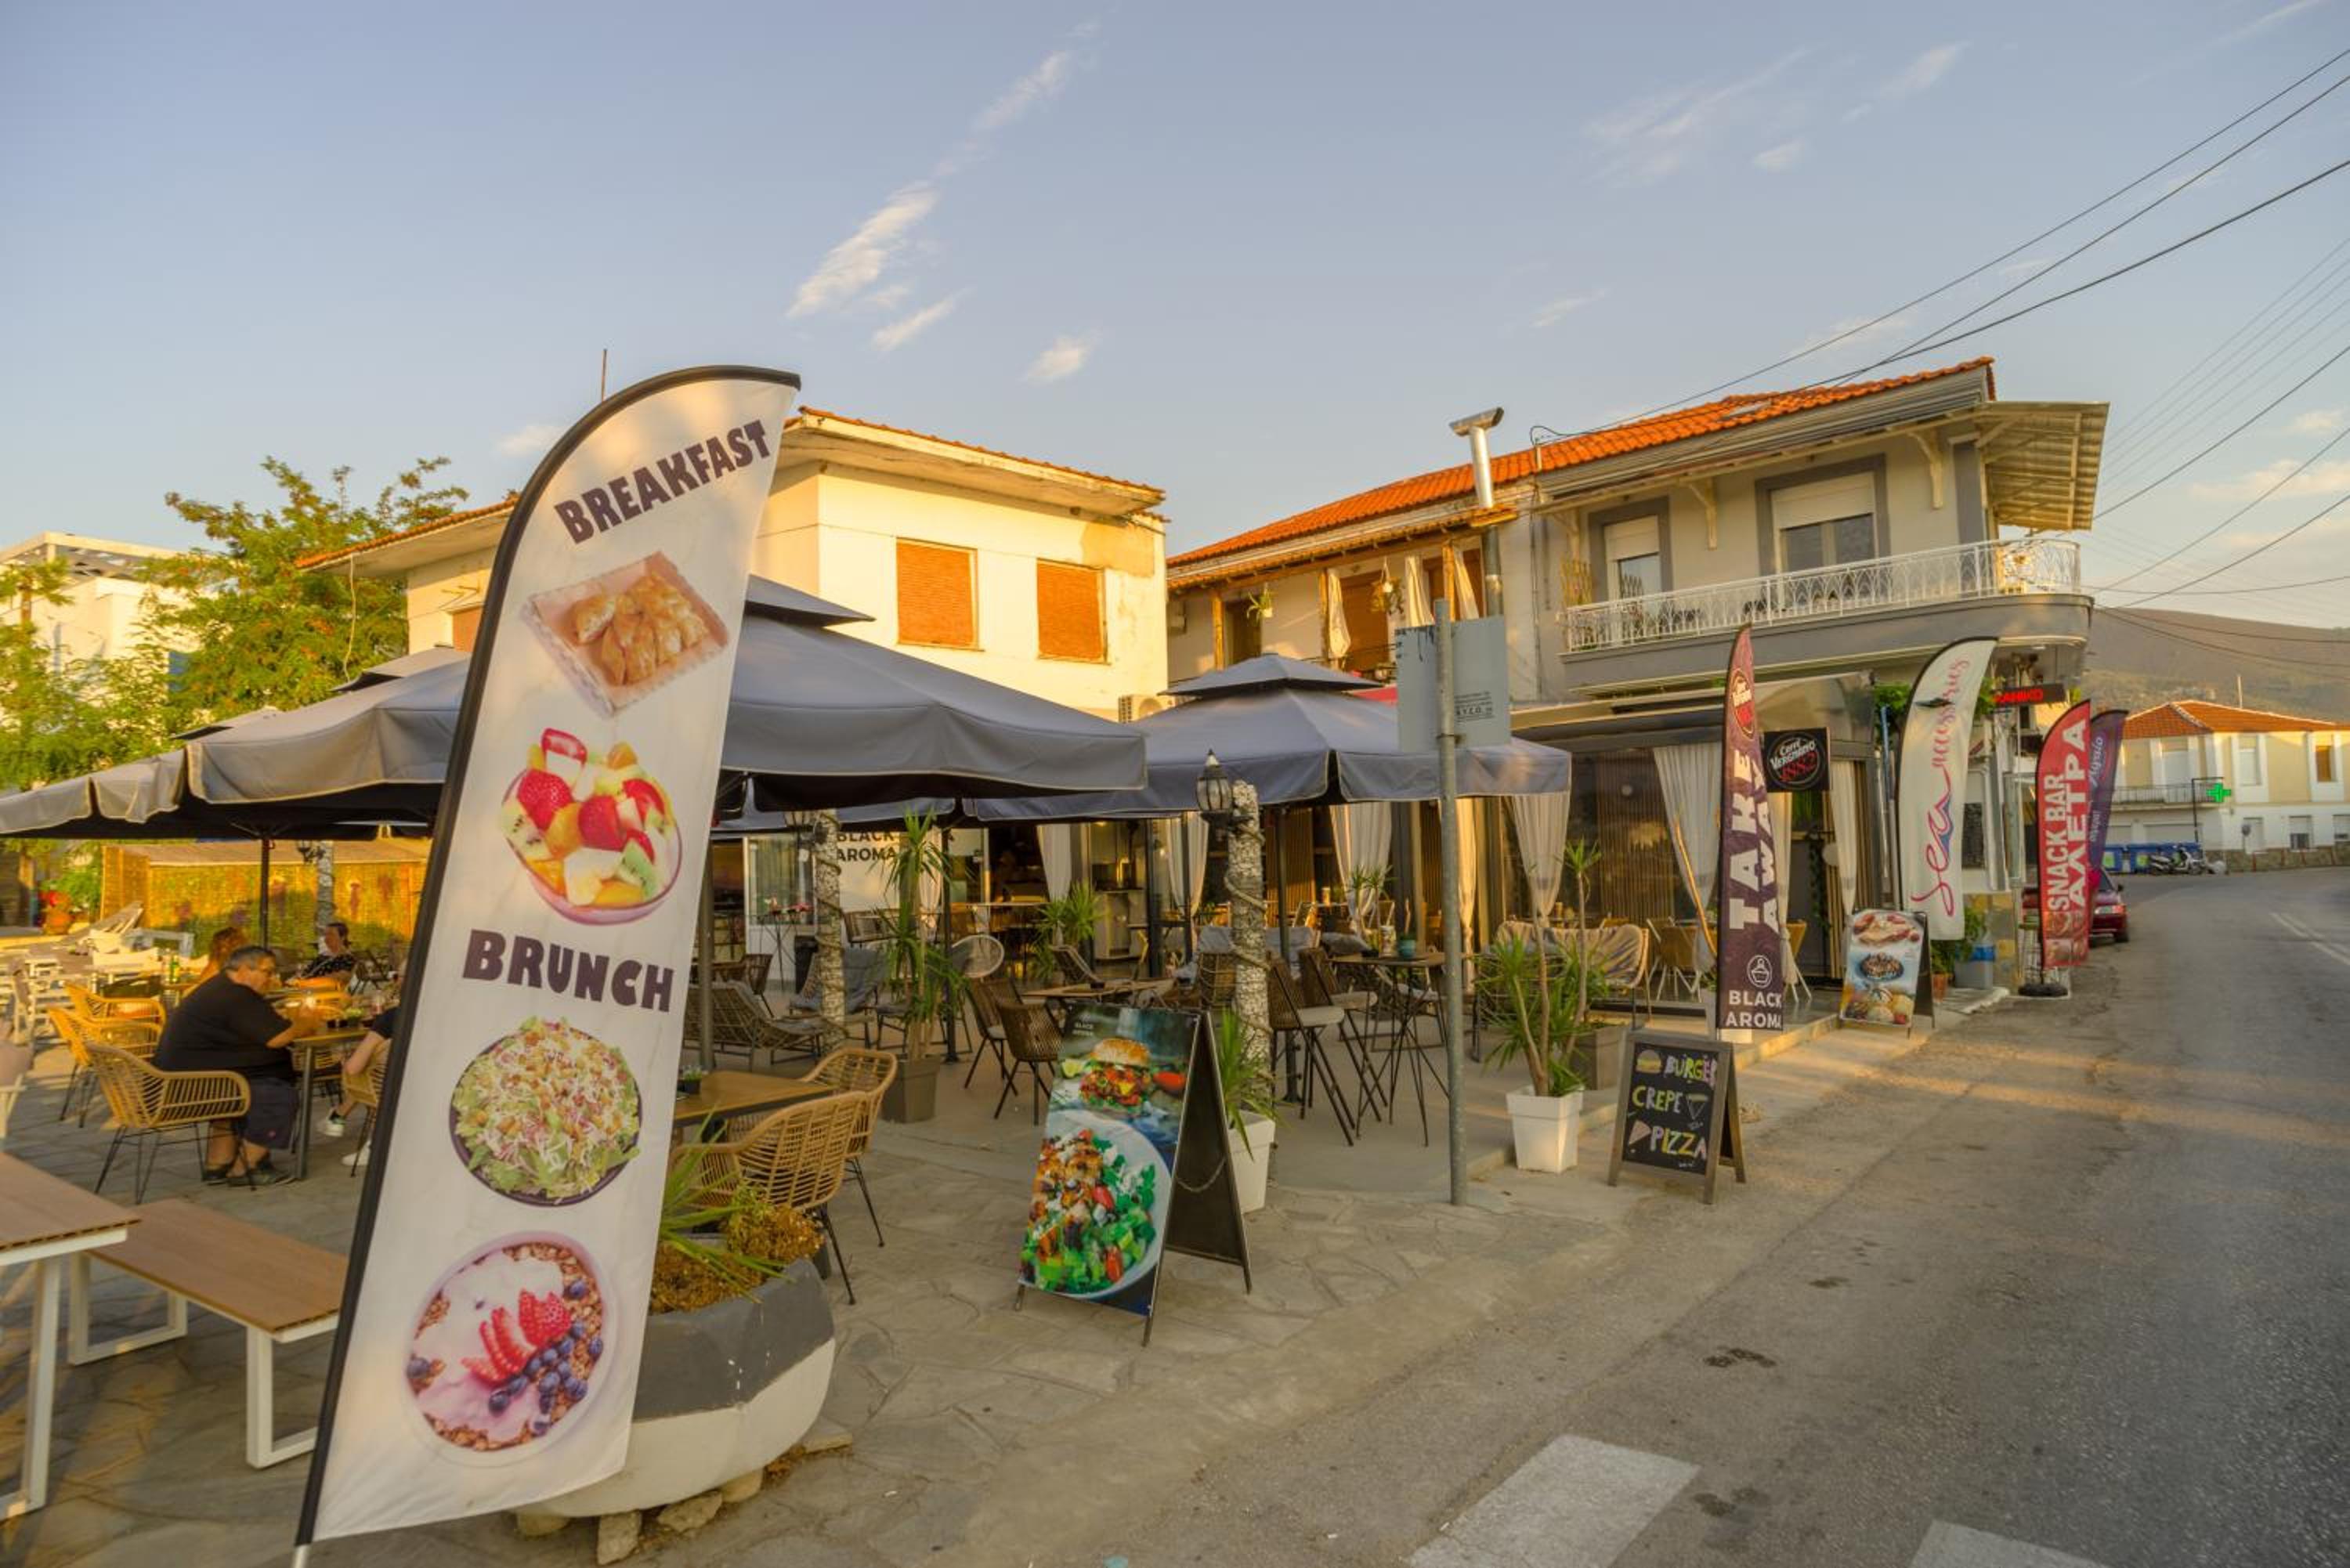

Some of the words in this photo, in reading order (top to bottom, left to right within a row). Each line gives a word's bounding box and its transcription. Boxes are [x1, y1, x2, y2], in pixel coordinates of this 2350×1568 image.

[553, 419, 771, 544] BREAKFAST
[2044, 773, 2067, 822] BAR
[836, 831, 895, 843] BLACK
[836, 847, 898, 862] AROMA
[1729, 749, 1760, 930] TAKE
[1752, 758, 1780, 935] AWAY
[2044, 830, 2070, 911] SNACK
[462, 929, 674, 1013] BRUNCH
[1663, 1053, 1718, 1089] BURGER
[1631, 1084, 1684, 1114] CREPE
[1650, 1125, 1708, 1160] PIZZA
